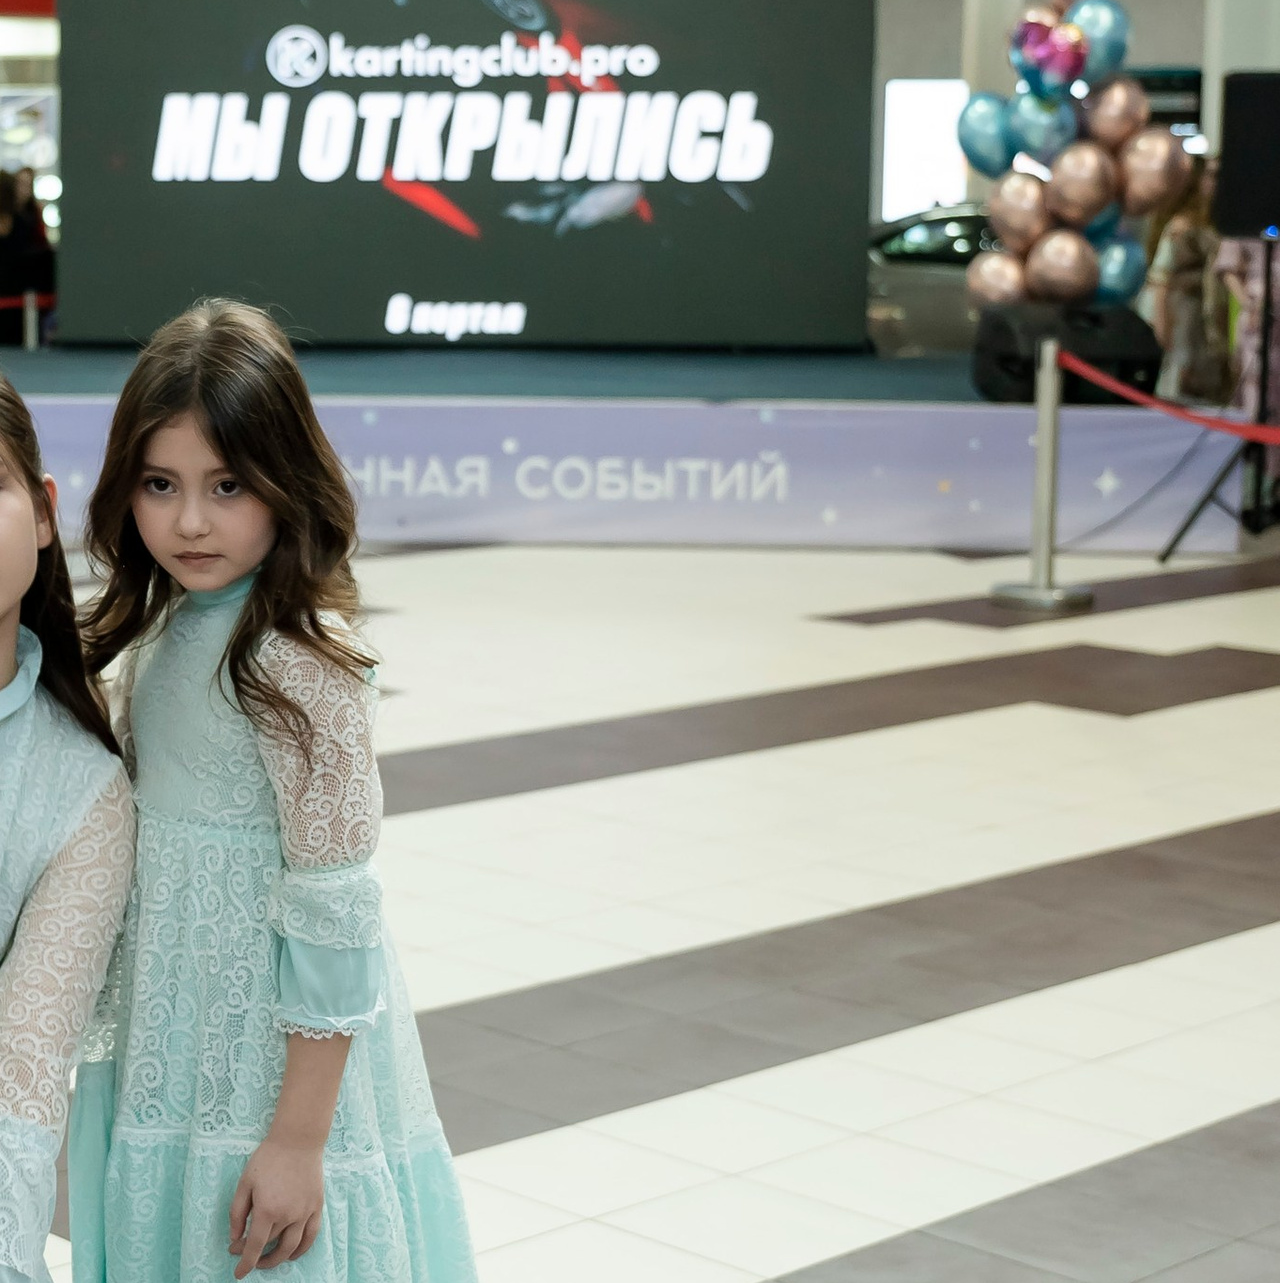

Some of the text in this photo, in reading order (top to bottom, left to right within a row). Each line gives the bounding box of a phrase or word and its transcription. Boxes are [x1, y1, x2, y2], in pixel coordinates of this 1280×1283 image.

[328, 31, 660, 87] kartingclub.pro
[152, 90, 774, 183] МЫ ОТКРЫЛИСЬ
[515, 450, 788, 501] СОБЫТИЙ
